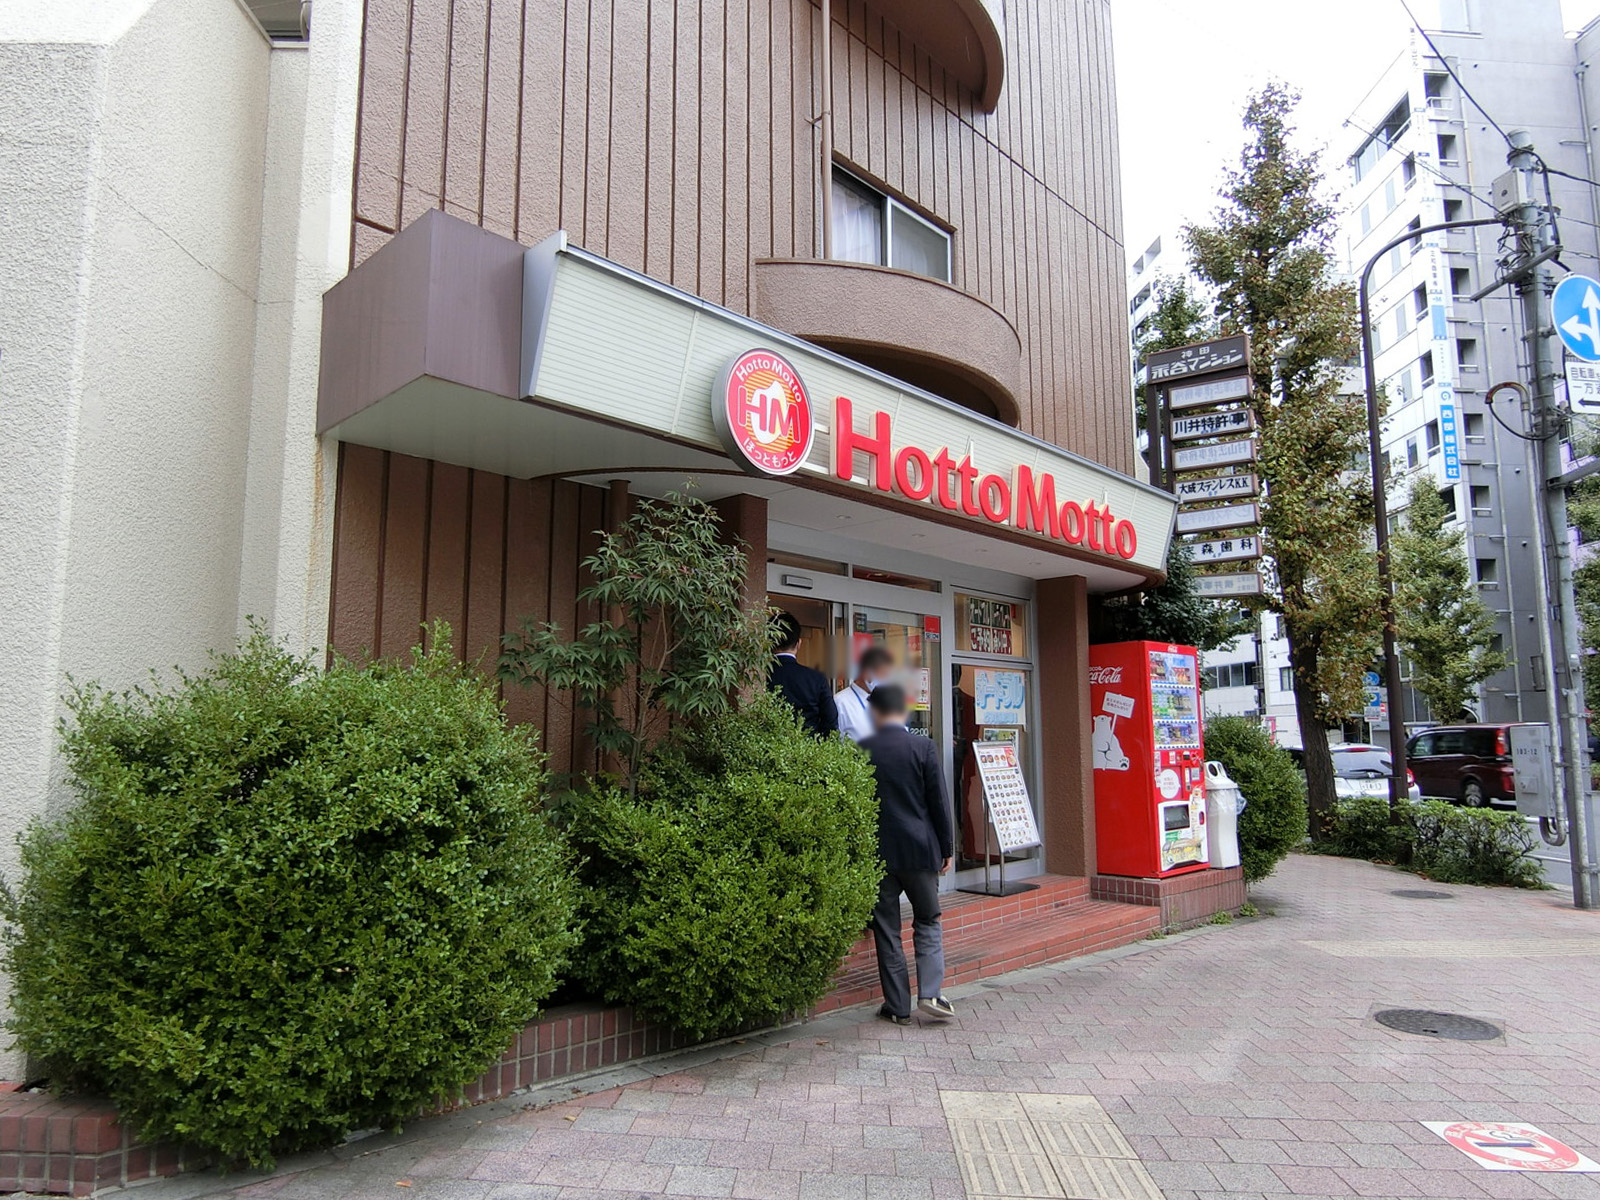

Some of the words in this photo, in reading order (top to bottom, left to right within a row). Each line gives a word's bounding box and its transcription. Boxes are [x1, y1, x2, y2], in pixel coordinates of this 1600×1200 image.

[1181, 346, 1210, 359] 神田
[736, 358, 770, 382] Hotto
[771, 361, 802, 403] Motto
[737, 384, 801, 443] HM
[742, 437, 797, 467] ほっともっと
